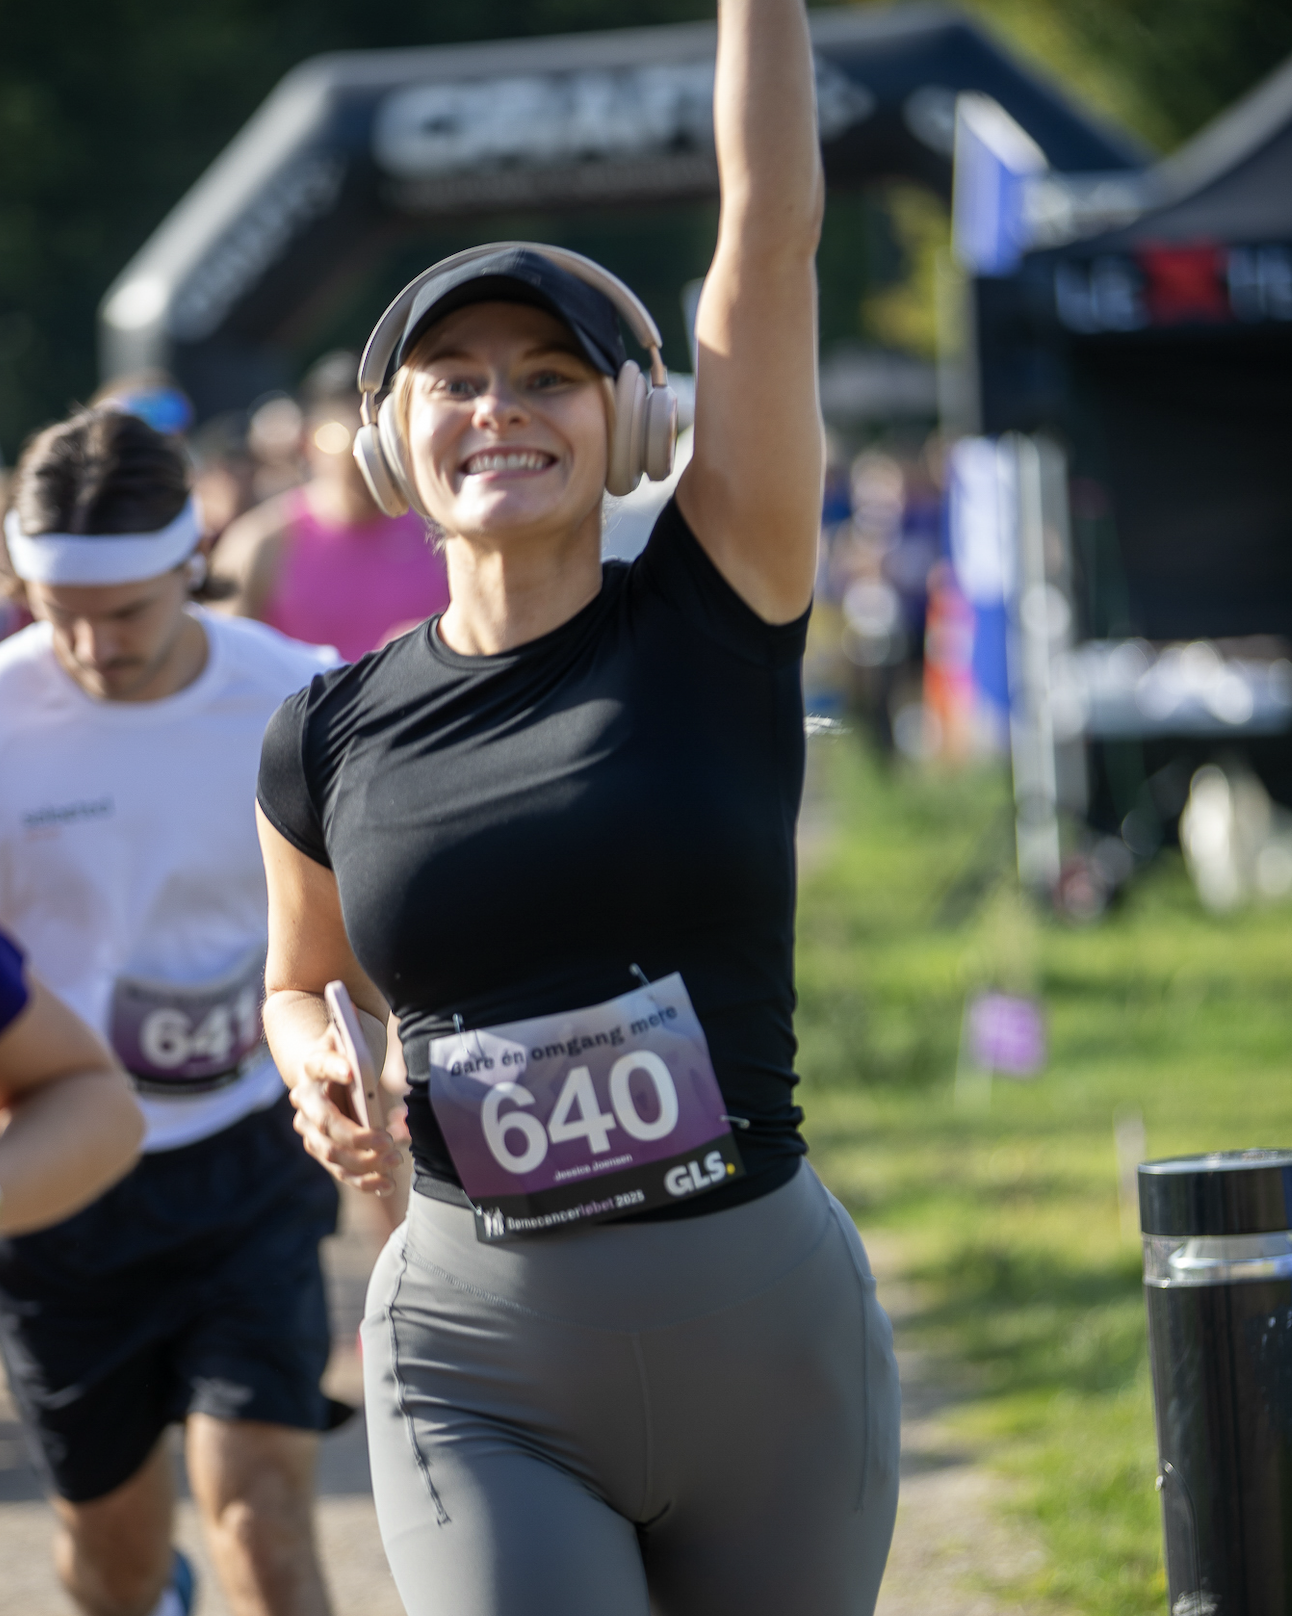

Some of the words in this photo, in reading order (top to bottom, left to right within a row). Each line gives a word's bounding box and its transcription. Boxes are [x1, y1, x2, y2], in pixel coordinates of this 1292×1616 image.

[502, 1049, 525, 1067] én
[531, 1026, 625, 1061] omgang
[630, 1006, 678, 1035] mere
[480, 1049, 679, 1174] 640
